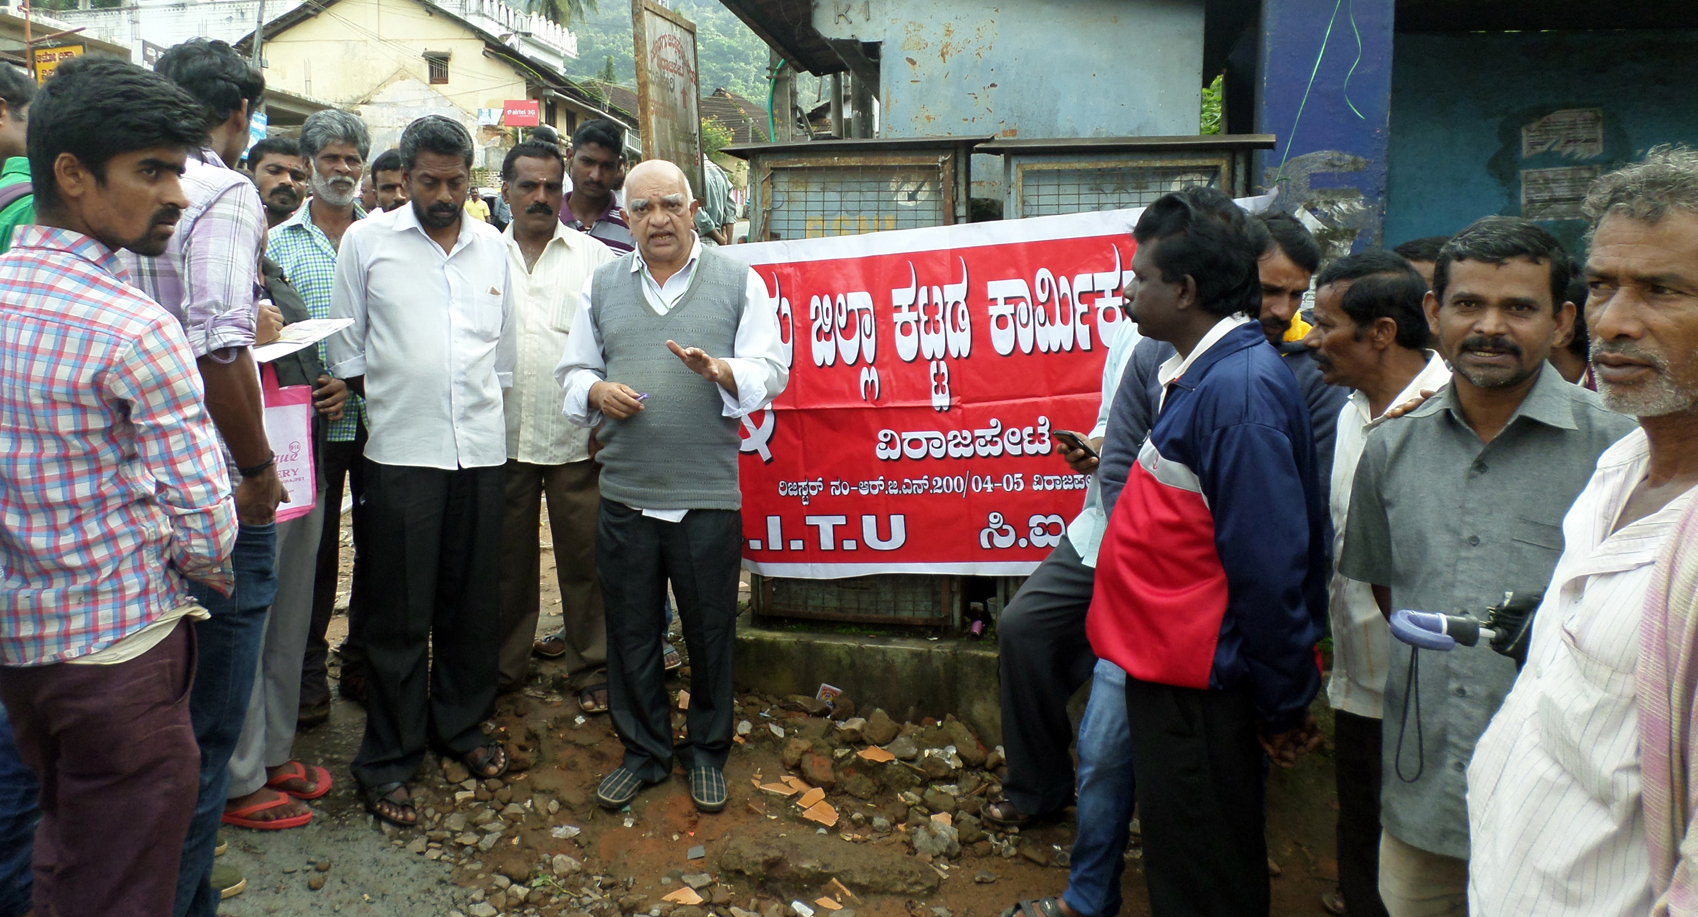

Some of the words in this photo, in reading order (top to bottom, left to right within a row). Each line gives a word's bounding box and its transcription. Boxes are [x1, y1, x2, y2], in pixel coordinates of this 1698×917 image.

[810, 292, 880, 401] ಜಿಲ್ಲಾ
[891, 256, 973, 412] ಕಟ್ಟಡ
[875, 415, 1052, 460] ವಿರಾಜಪೇಟೆ
[742, 514, 908, 551] .I.T.U
